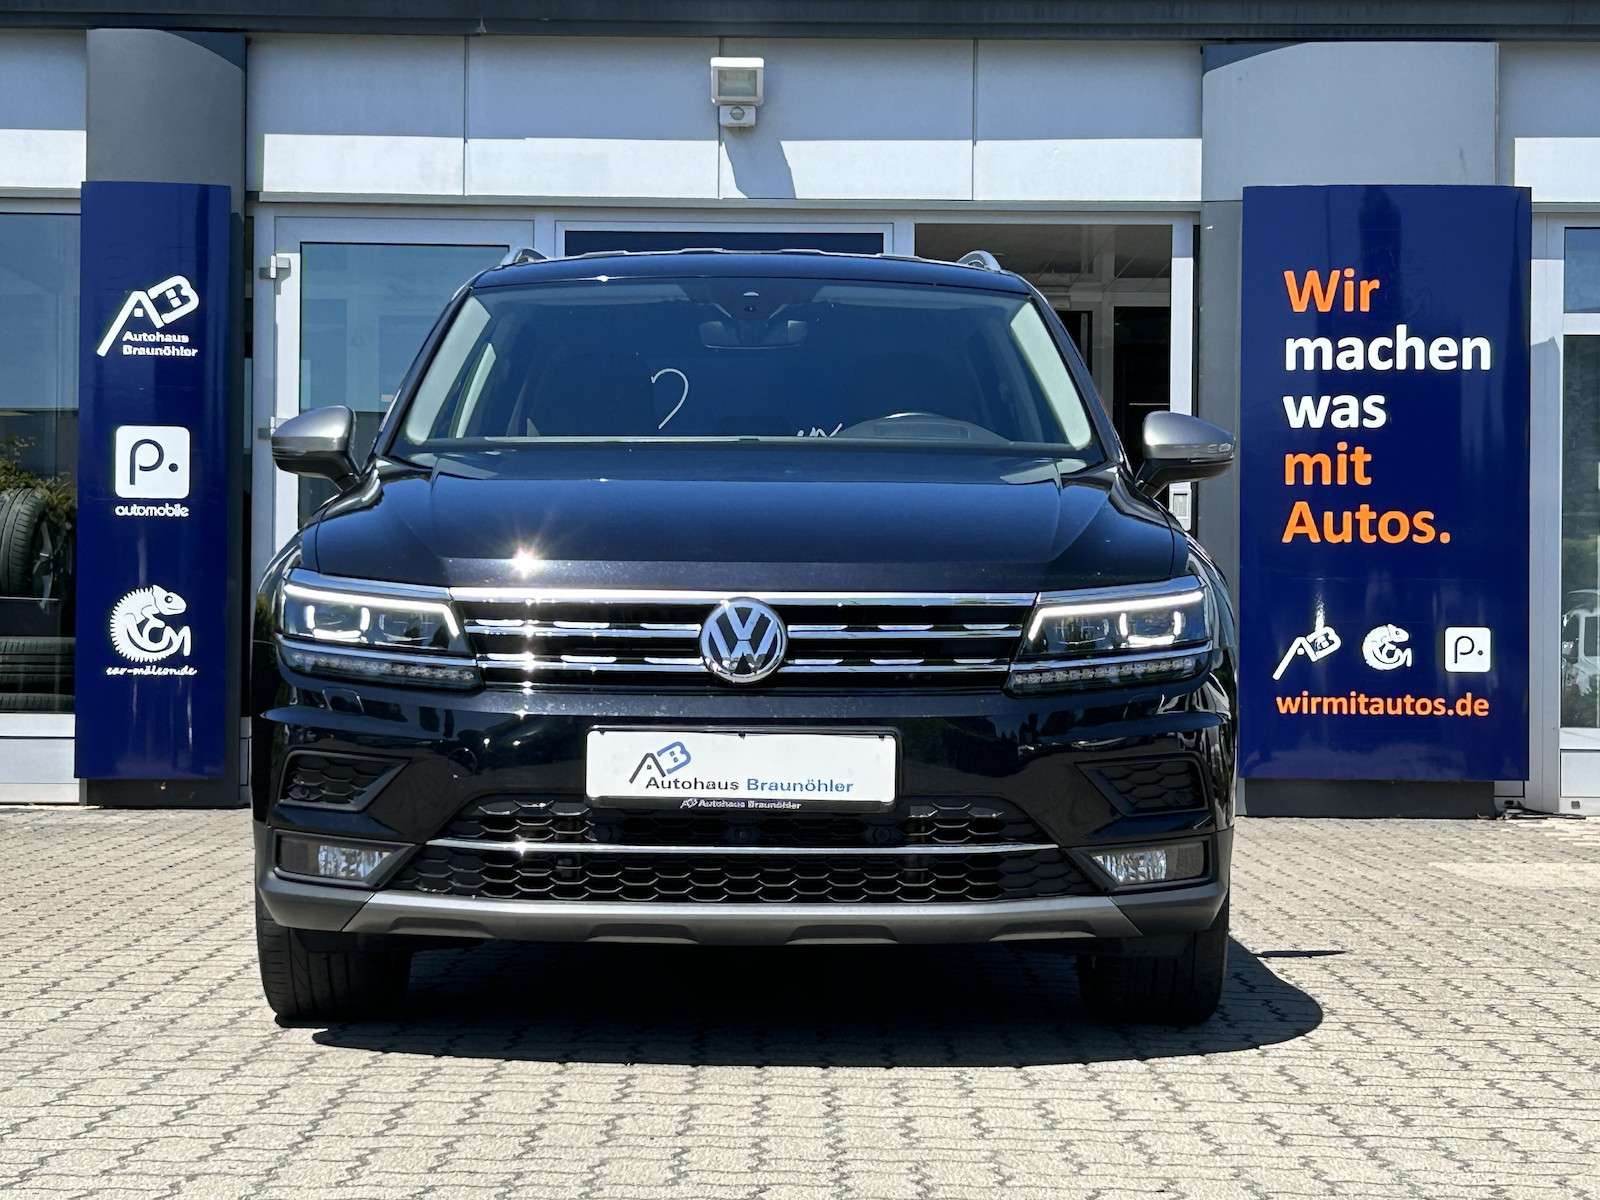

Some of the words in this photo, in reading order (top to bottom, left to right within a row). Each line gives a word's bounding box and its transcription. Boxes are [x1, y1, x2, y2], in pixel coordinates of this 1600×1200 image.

[1284, 268, 1381, 313] Wir
[122, 331, 190, 343] Autohaus
[122, 344, 199, 357] Braunöhler
[1284, 324, 1491, 371] machen
[1283, 394, 1387, 429] was
[1284, 441, 1372, 486] mit
[114, 502, 190, 517] automobile
[1281, 500, 1451, 544] Autos.
[702, 599, 786, 682] VW
[1276, 690, 1490, 717] wirmitautos.de
[645, 777, 740, 791] Autohaus
[746, 777, 855, 793] Braunöhler
[698, 799, 746, 809] Autohaus
[747, 800, 802, 811] Braunöhler
